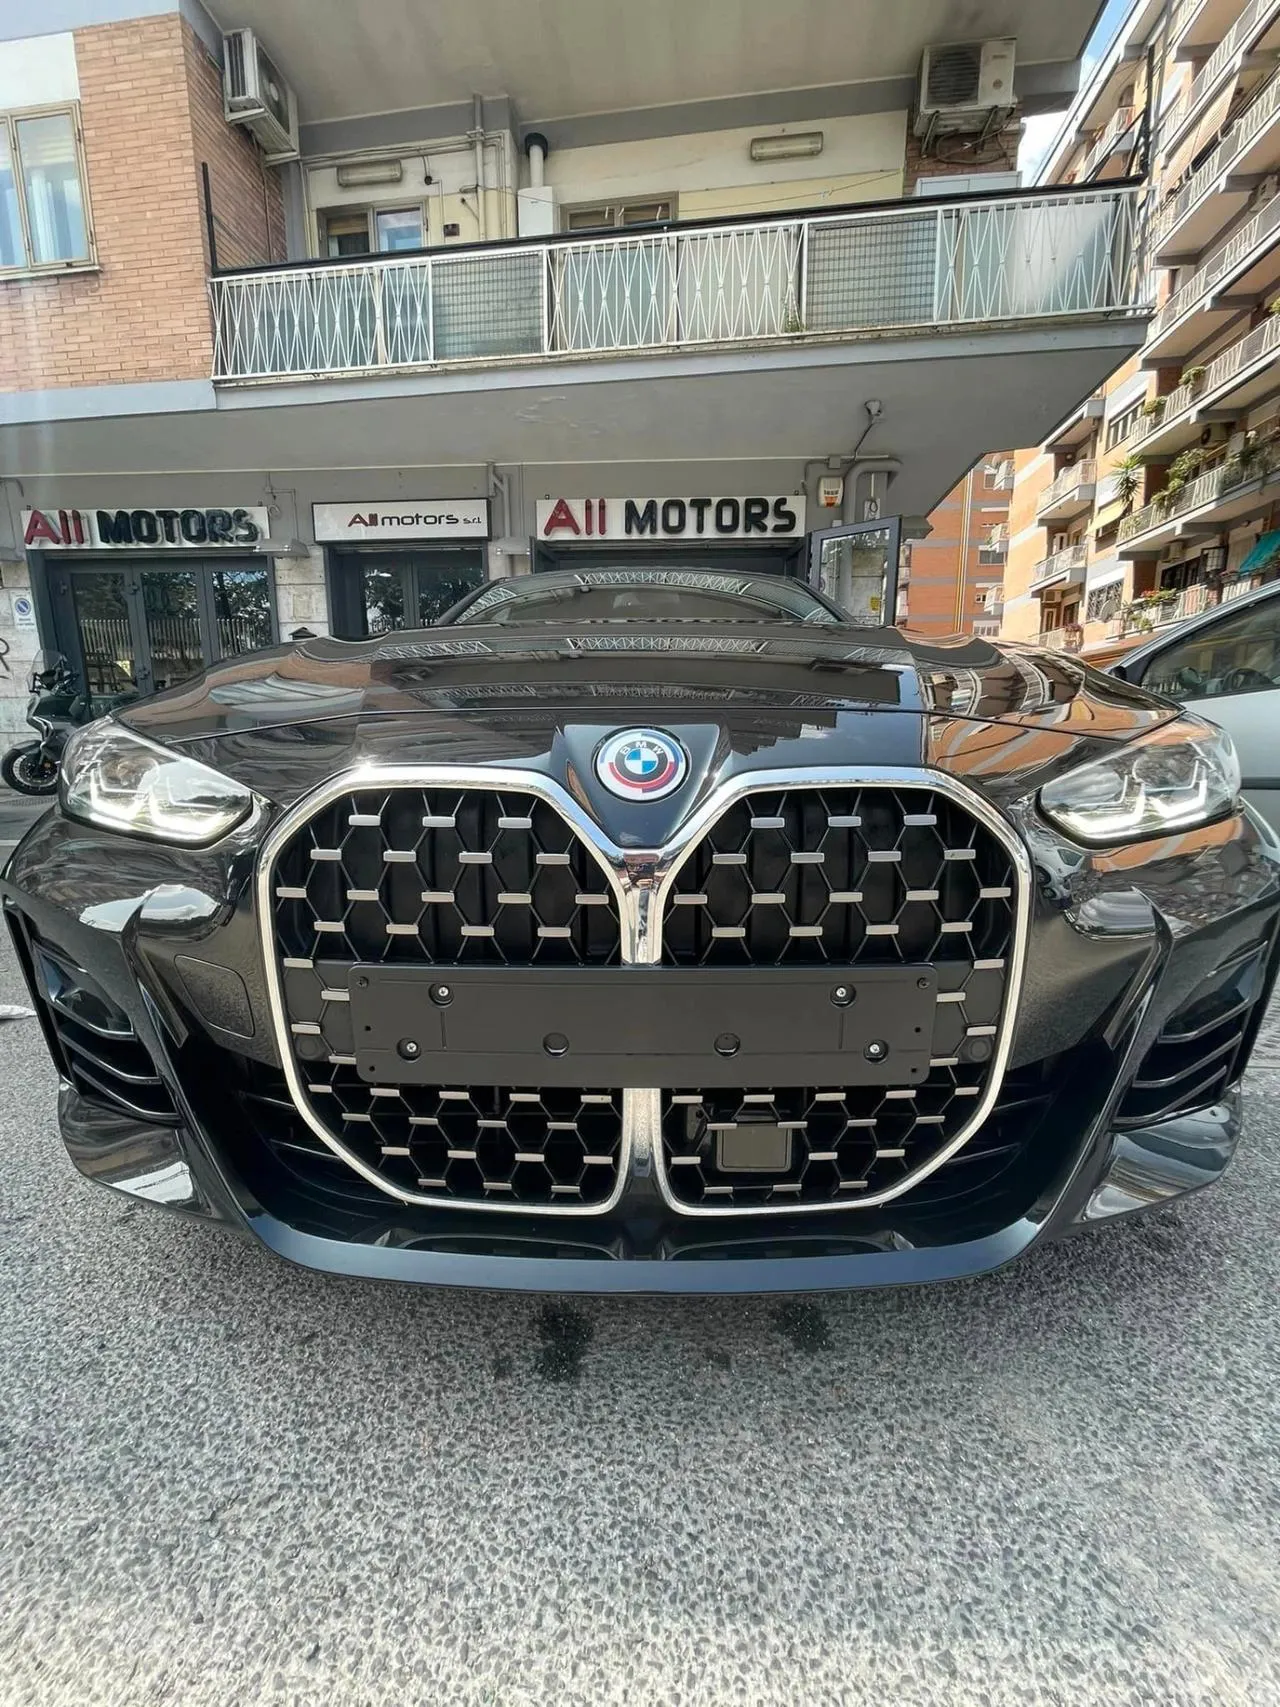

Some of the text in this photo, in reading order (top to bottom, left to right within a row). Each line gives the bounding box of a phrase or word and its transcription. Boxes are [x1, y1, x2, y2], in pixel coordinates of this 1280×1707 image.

[24, 508, 260, 545] All MOTORS
[543, 497, 797, 536] All MOTORS
[620, 741, 664, 755] BMW
